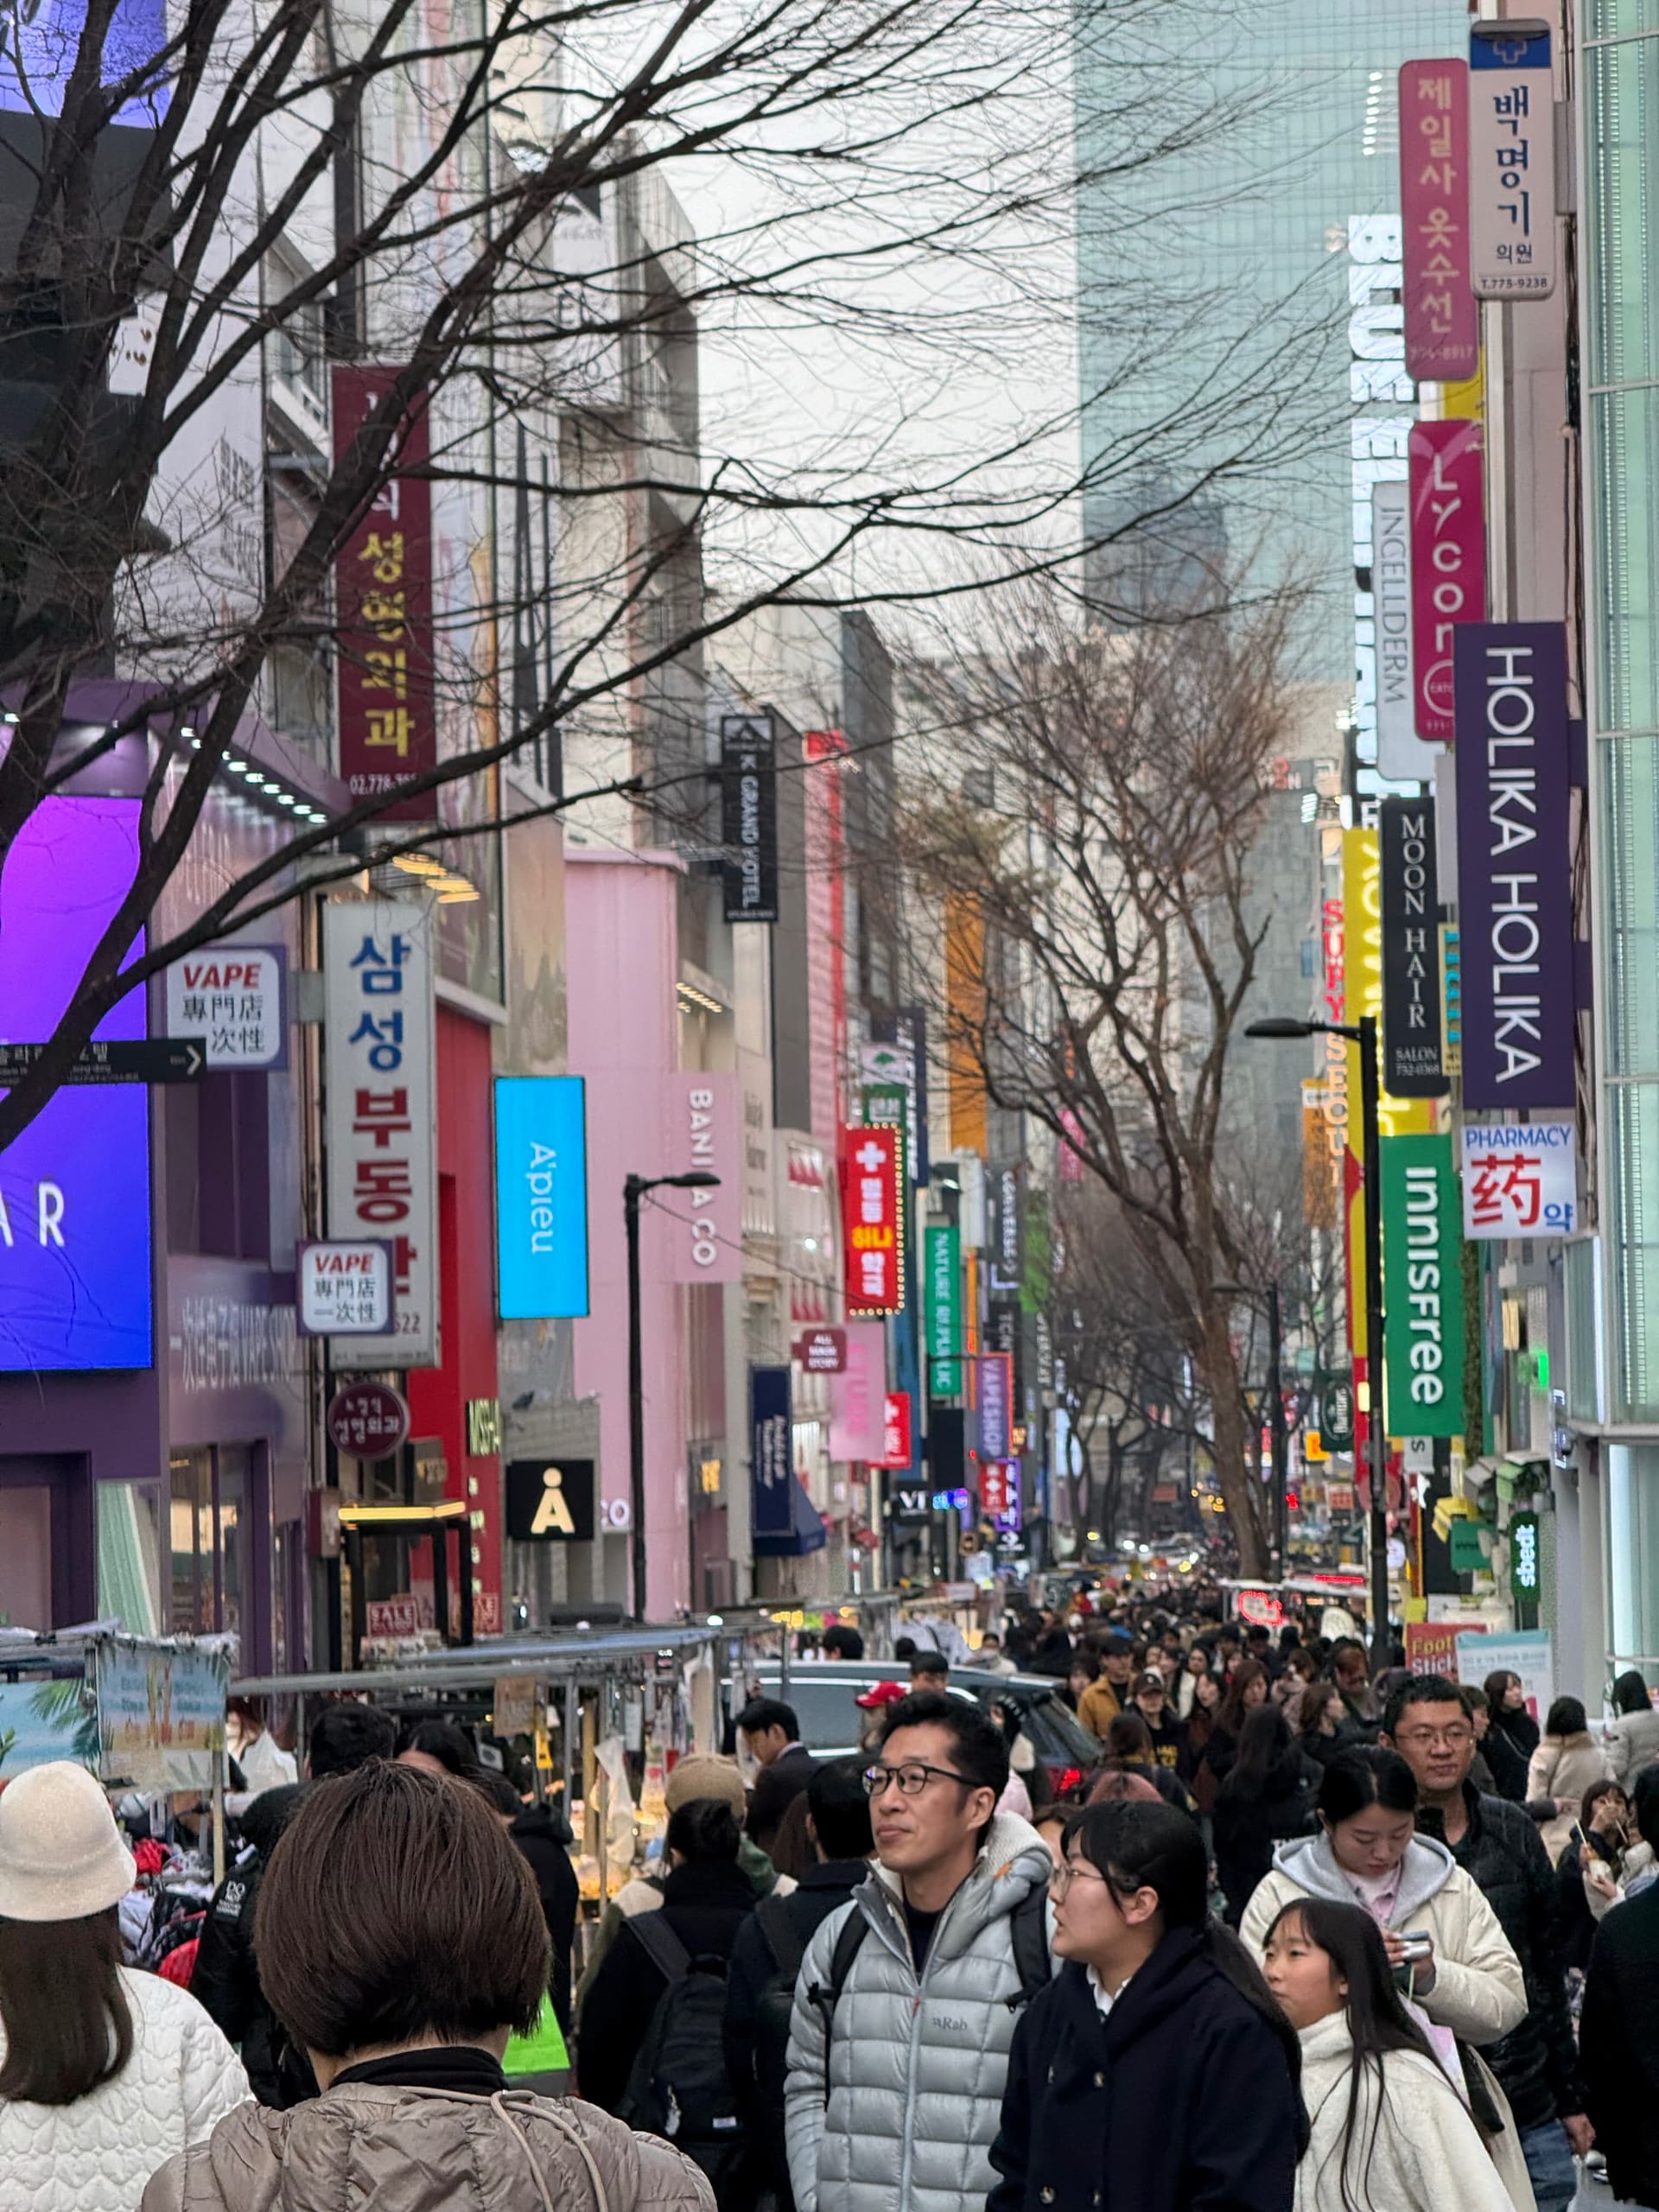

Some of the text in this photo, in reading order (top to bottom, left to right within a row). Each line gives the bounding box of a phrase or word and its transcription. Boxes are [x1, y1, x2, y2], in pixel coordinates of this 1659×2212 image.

[1493, 86, 1529, 237] 백명기
[1418, 77, 1461, 334] 제일사 옷수선
[1496, 243, 1533, 265] 의원
[741, 775, 760, 844] GRAND
[1485, 646, 1542, 1084] HOLIKA HOLIKA
[1401, 814, 1427, 1028] MOON HAIR
[182, 962, 263, 990] VAPE
[182, 995, 264, 1023] 專門店
[348, 933, 412, 1072] 삼성
[1465, 1125, 1572, 1149] PHARMACY
[690, 1089, 717, 1266] BANIA CO
[1471, 1152, 1541, 1228] 药
[1543, 1201, 1573, 1232] 약
[315, 1254, 374, 1274] VAPE
[934, 1231, 950, 1301] NATURE
[314, 1303, 376, 1325] 一次性
[942, 2016, 968, 2031] Rab
